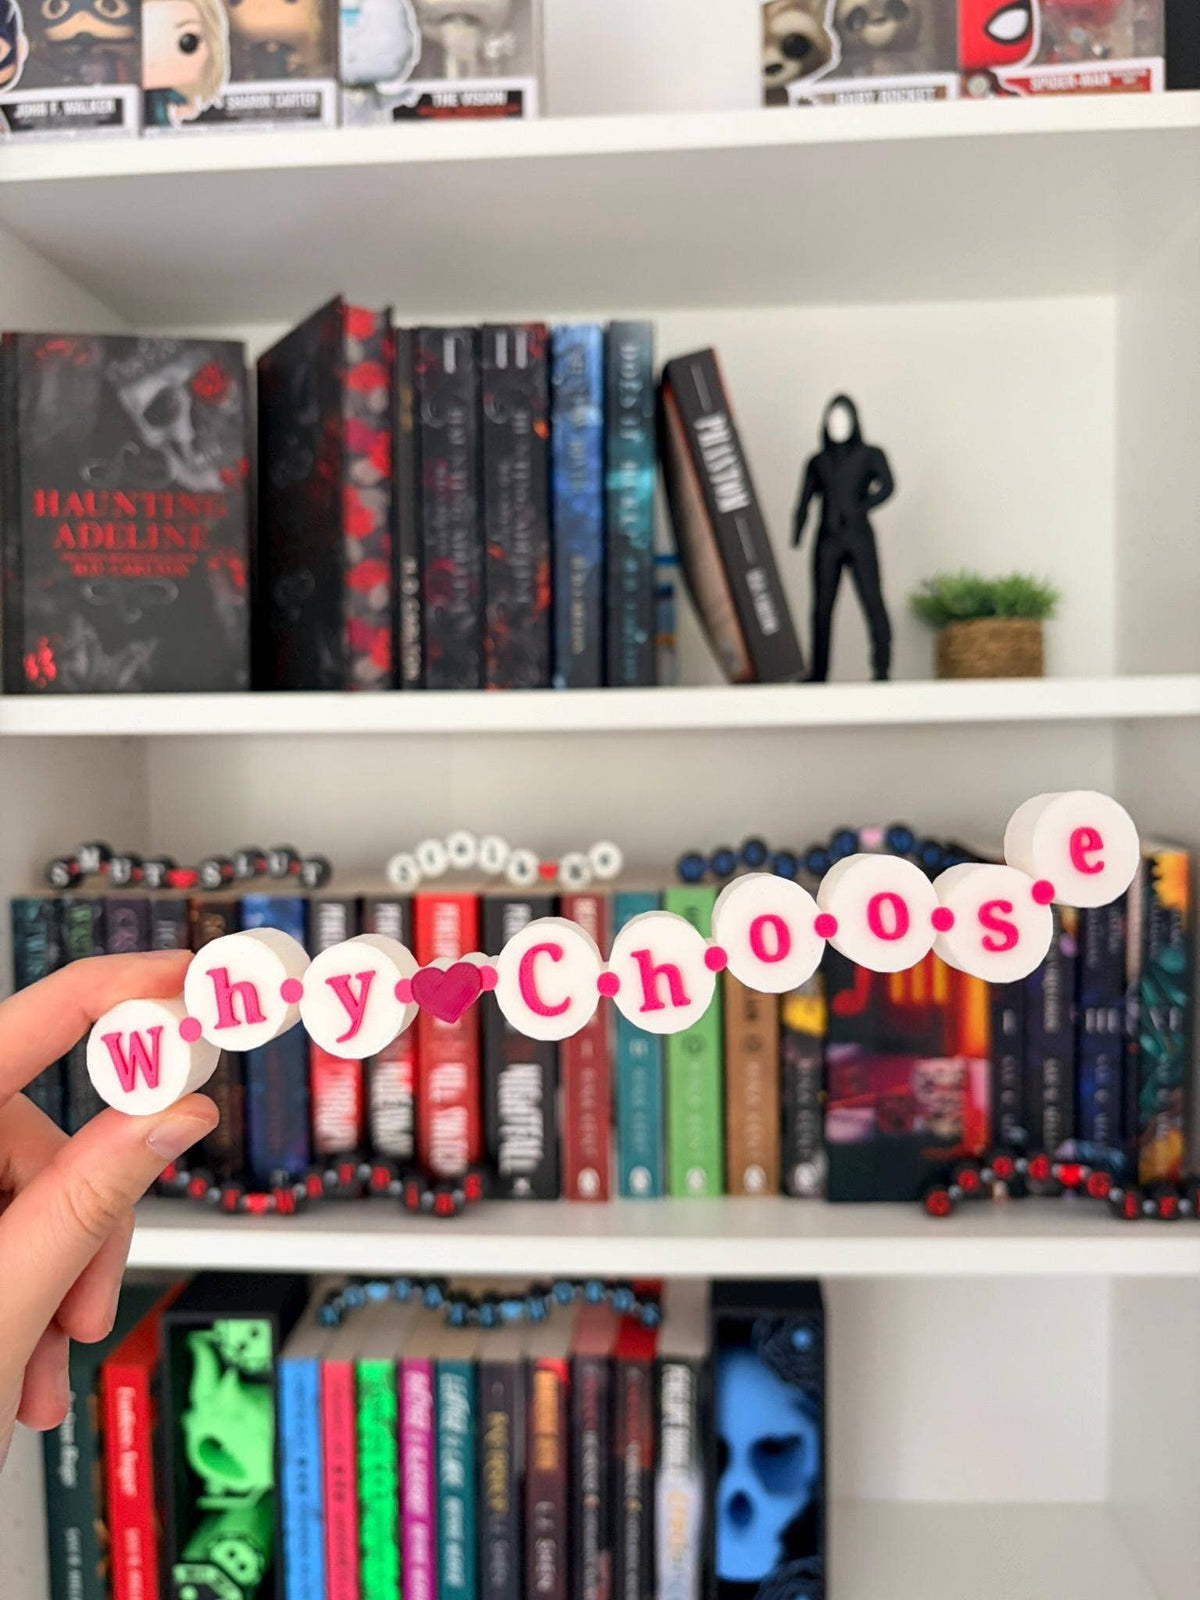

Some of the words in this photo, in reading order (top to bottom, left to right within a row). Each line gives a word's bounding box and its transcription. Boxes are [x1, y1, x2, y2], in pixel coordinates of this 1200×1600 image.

[15, 102, 46, 117] JOHN
[65, 98, 116, 115] WALKER
[433, 92, 459, 107] THE
[463, 90, 506, 106] VISION
[33, 488, 227, 520] HAUNTING
[53, 521, 209, 551] ADELINE
[518, 827, 1105, 1017] Choose
[430, 1062, 467, 1102] KILL
[498, 1063, 543, 1176] NIGHTFALL
[430, 1106, 469, 1177] SWITCH
